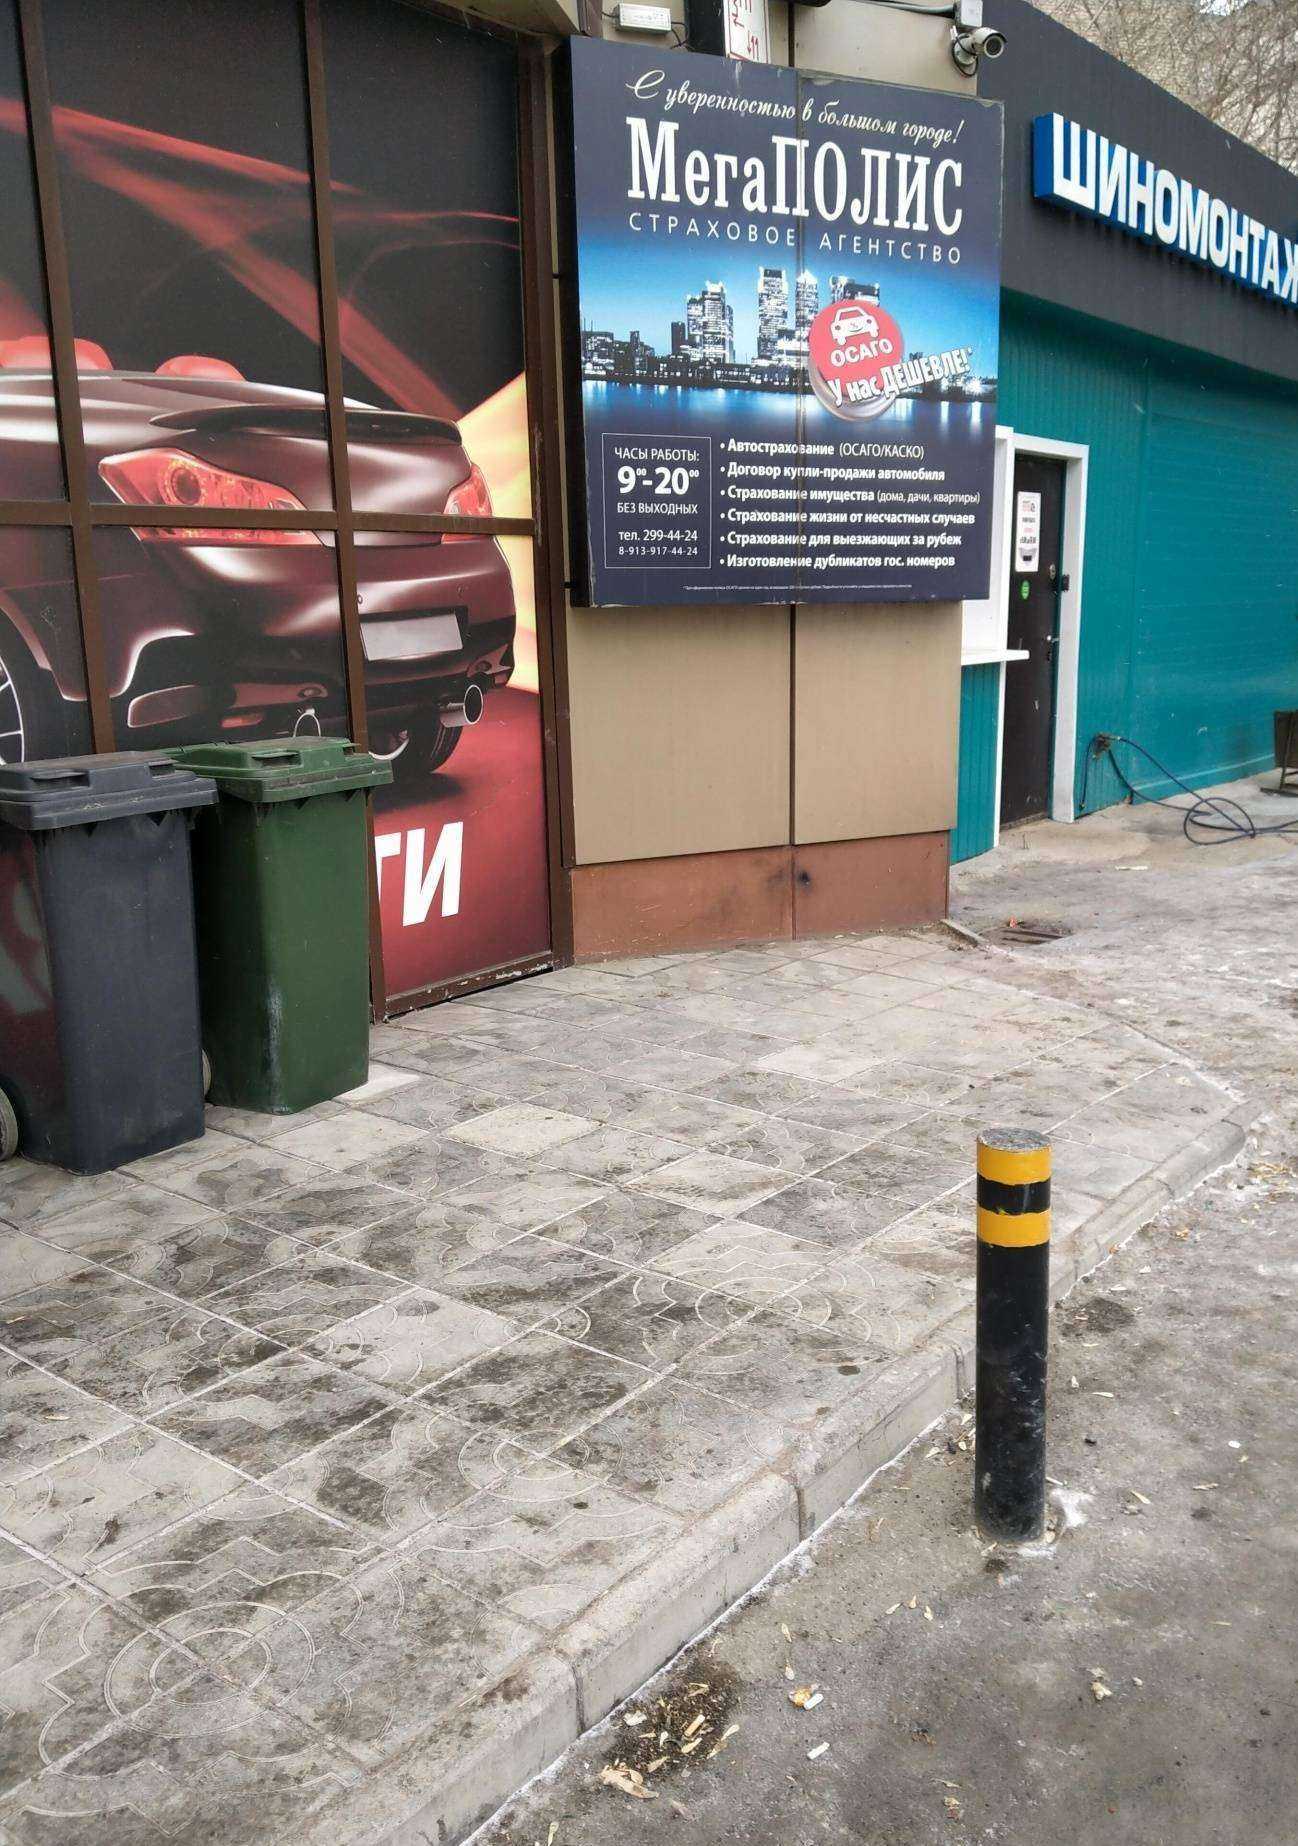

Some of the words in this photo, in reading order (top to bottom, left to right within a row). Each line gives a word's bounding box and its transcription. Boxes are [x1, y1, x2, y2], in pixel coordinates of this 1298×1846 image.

[625, 69, 665, 98] С
[664, 80, 796, 119] уверенностью
[802, 98, 814, 121] в
[818, 100, 897, 134] большом
[902, 119, 964, 149] городе!
[625, 117, 962, 235] МегаПОЛИС
[629, 212, 795, 246] СТРАХОВОЕ
[819, 234, 961, 265] АГЕНТСТВО
[830, 338, 893, 367] ОСАГО
[827, 378, 843, 408] У
[846, 377, 881, 402] нас
[615, 447, 648, 460] ЧАСЫ
[651, 449, 700, 461] РАБОТЫ:
[727, 438, 835, 456] Автострахование
[839, 442, 924, 459] (ОСАГО/КАСКО)
[727, 462, 781, 479] Договор
[783, 467, 876, 481] купли-продажи
[878, 468, 945, 480] автомобиля
[727, 485, 808, 501] Страхование
[810, 490, 874, 503] имущества
[934, 492, 980, 505] квартиры)
[617, 502, 636, 513] БЕЗ
[638, 503, 698, 515] ВЫХОДНЫХ
[727, 508, 808, 524] Страхование
[809, 512, 847, 522] жизни
[849, 513, 863, 523] от
[865, 513, 930, 523] несчастных
[932, 514, 975, 526] случаев
[618, 531, 640, 541] тел.
[643, 529, 698, 541] 299-44-24
[727, 531, 807, 547] Страхование
[808, 535, 831, 547] для
[833, 535, 910, 547] выезжающих
[912, 536, 924, 545] за
[927, 532, 961, 548] рубеж
[618, 546, 698, 555] 8-913-917-44-24
[727, 554, 814, 567] Изготовление
[814, 554, 882, 570] дубликатов
[884, 557, 904, 566] гос.
[907, 557, 955, 569] номеров
